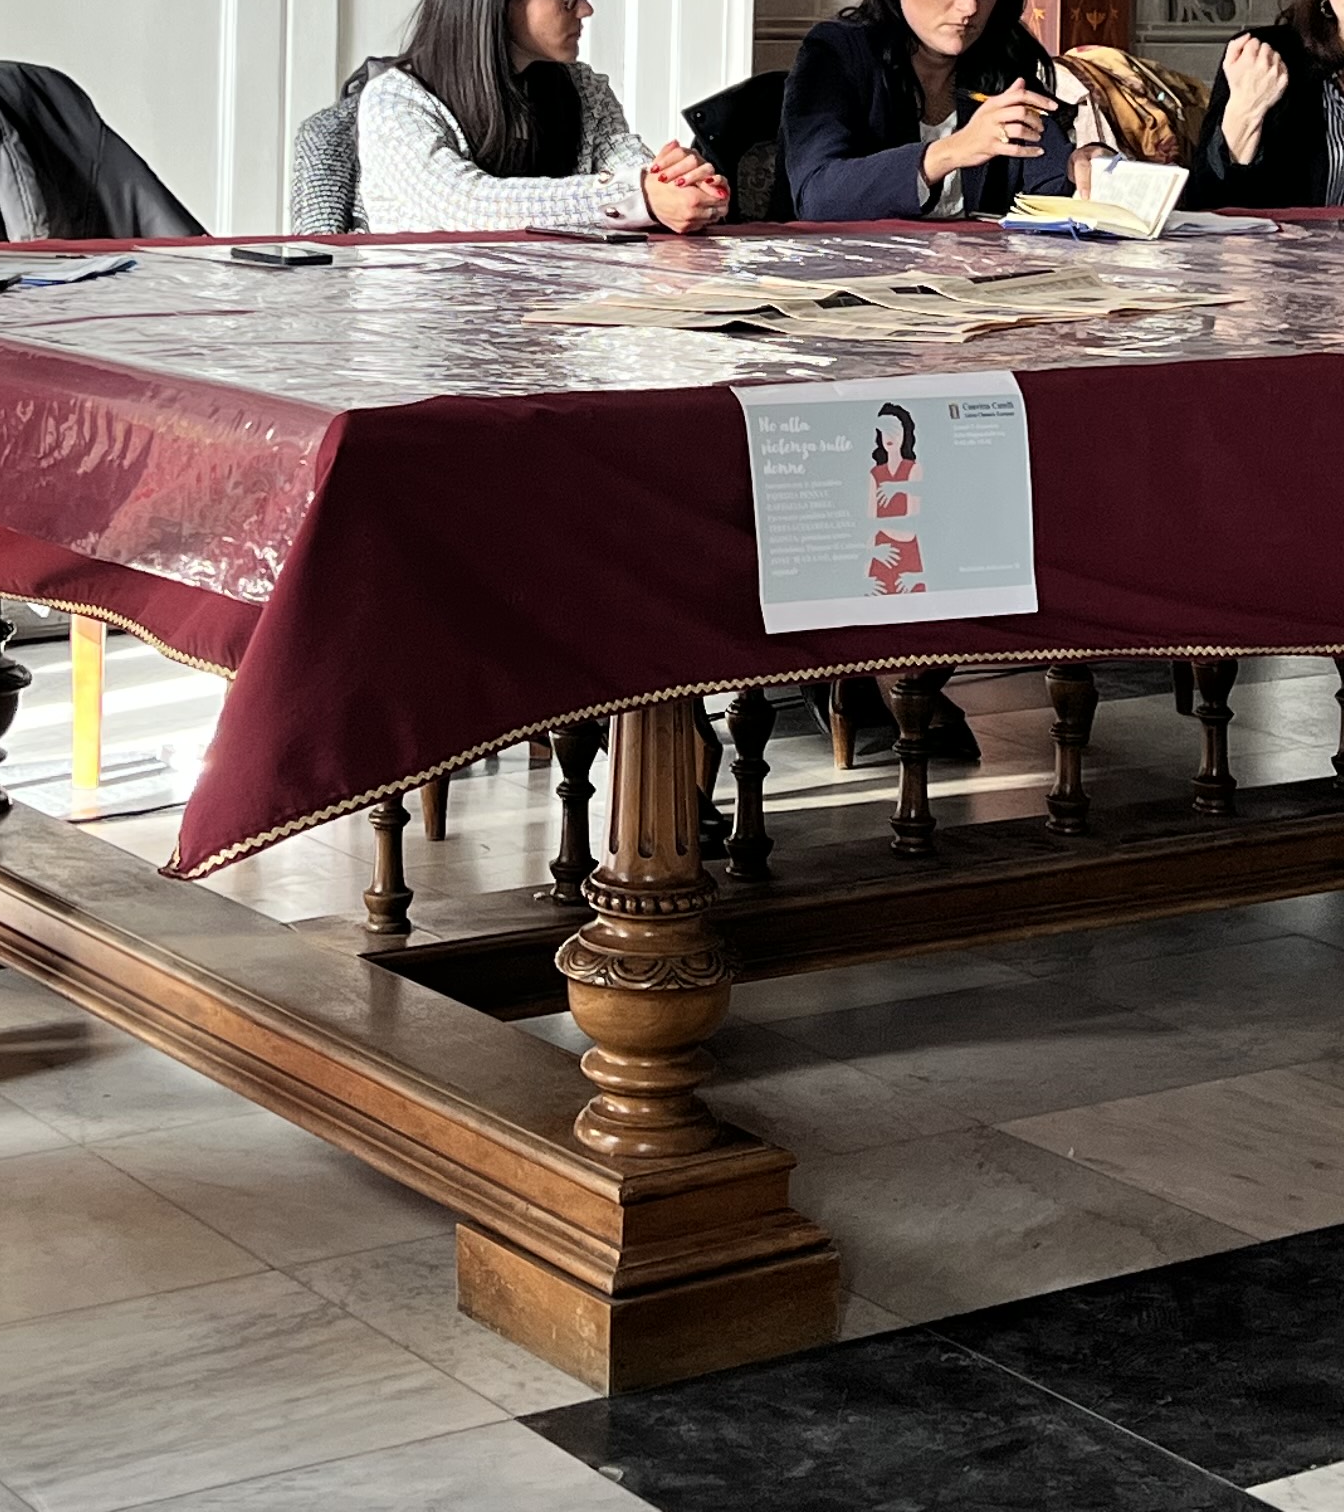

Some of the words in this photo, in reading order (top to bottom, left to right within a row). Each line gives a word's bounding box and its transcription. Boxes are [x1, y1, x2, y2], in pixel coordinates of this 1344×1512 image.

[758, 416, 777, 433] No
[779, 415, 810, 433] alla
[761, 438, 816, 460] violenza
[819, 435, 853, 452] sulle
[763, 458, 806, 475] donne
